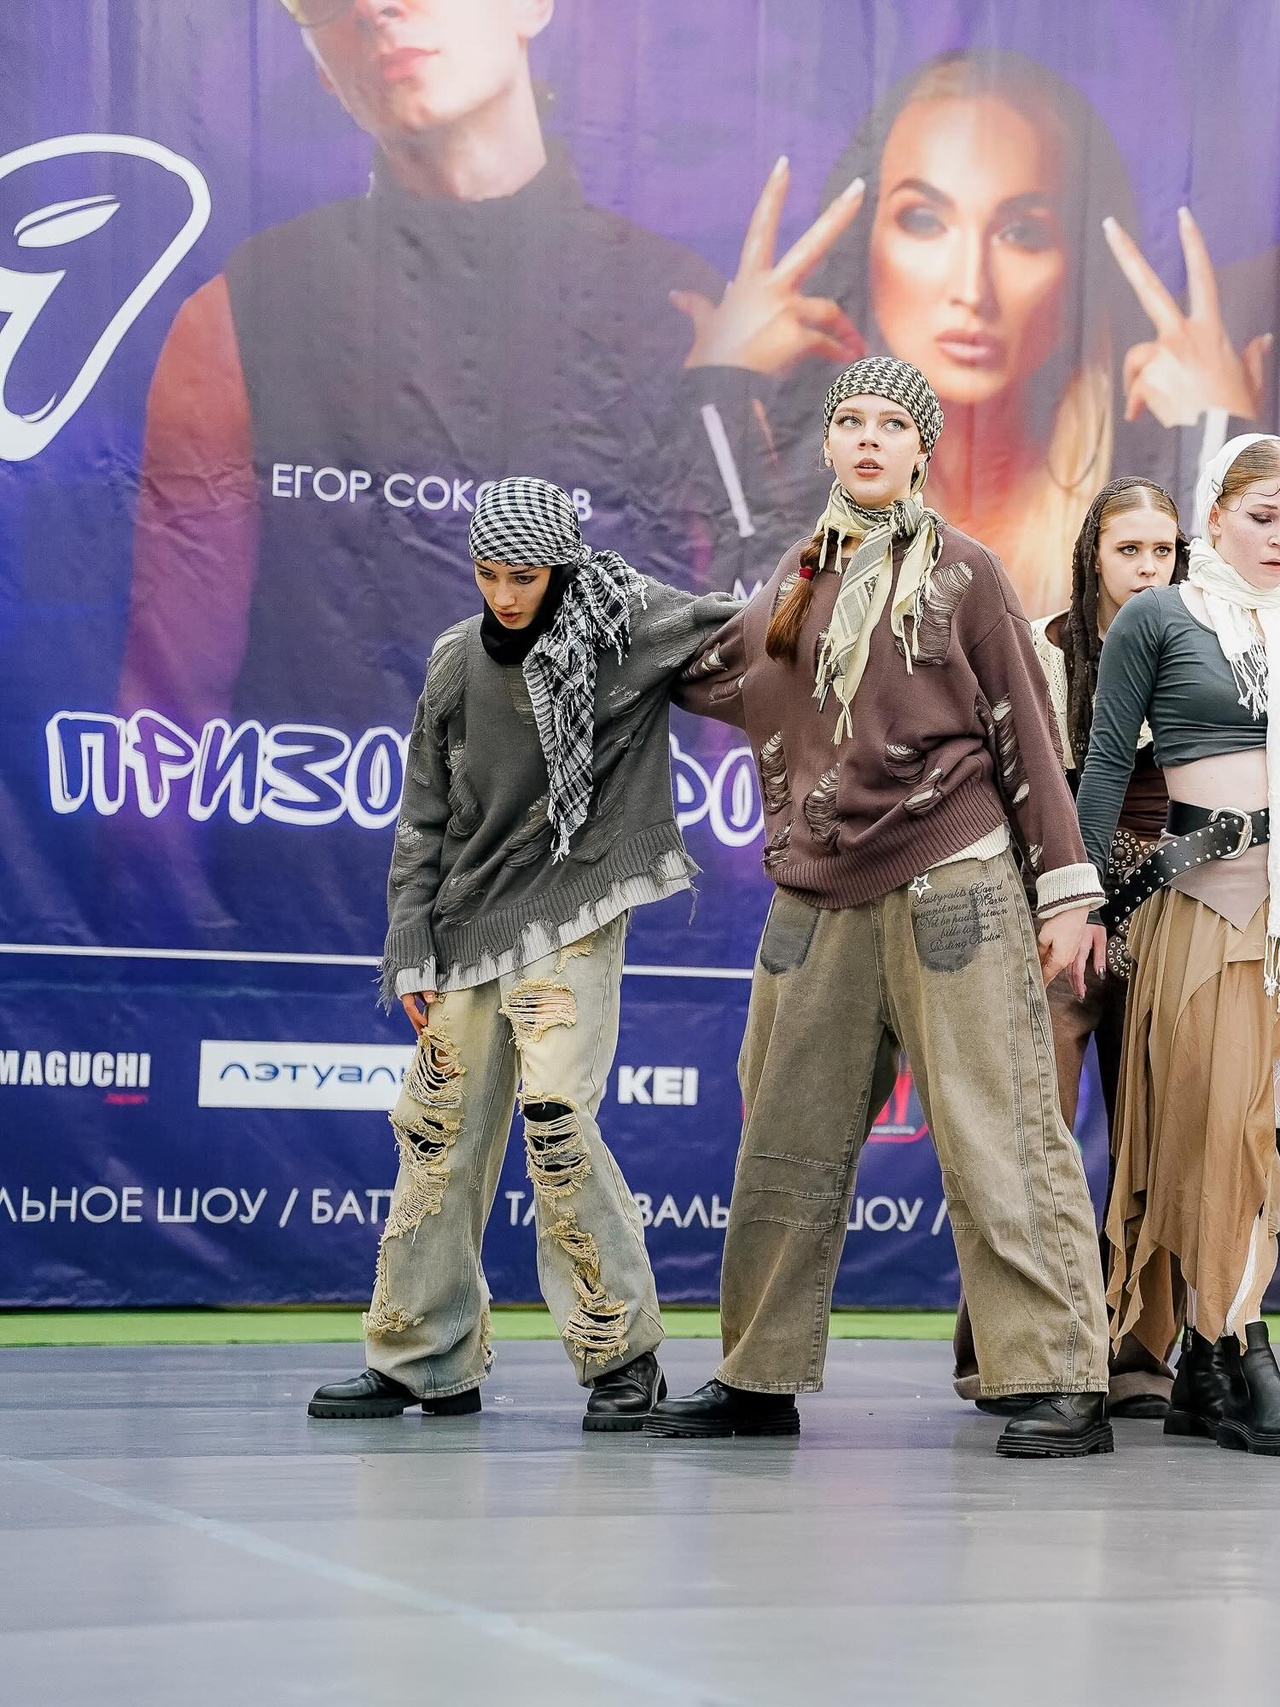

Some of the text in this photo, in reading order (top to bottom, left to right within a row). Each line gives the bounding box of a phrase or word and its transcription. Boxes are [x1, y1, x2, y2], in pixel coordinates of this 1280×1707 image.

[272, 463, 593, 522] ЕГОР СОКВ
[45, 708, 410, 830] ПРИЗО
[0, 1186, 143, 1223] ЛЬНОЕ
[157, 1186, 268, 1225] ШОУ
